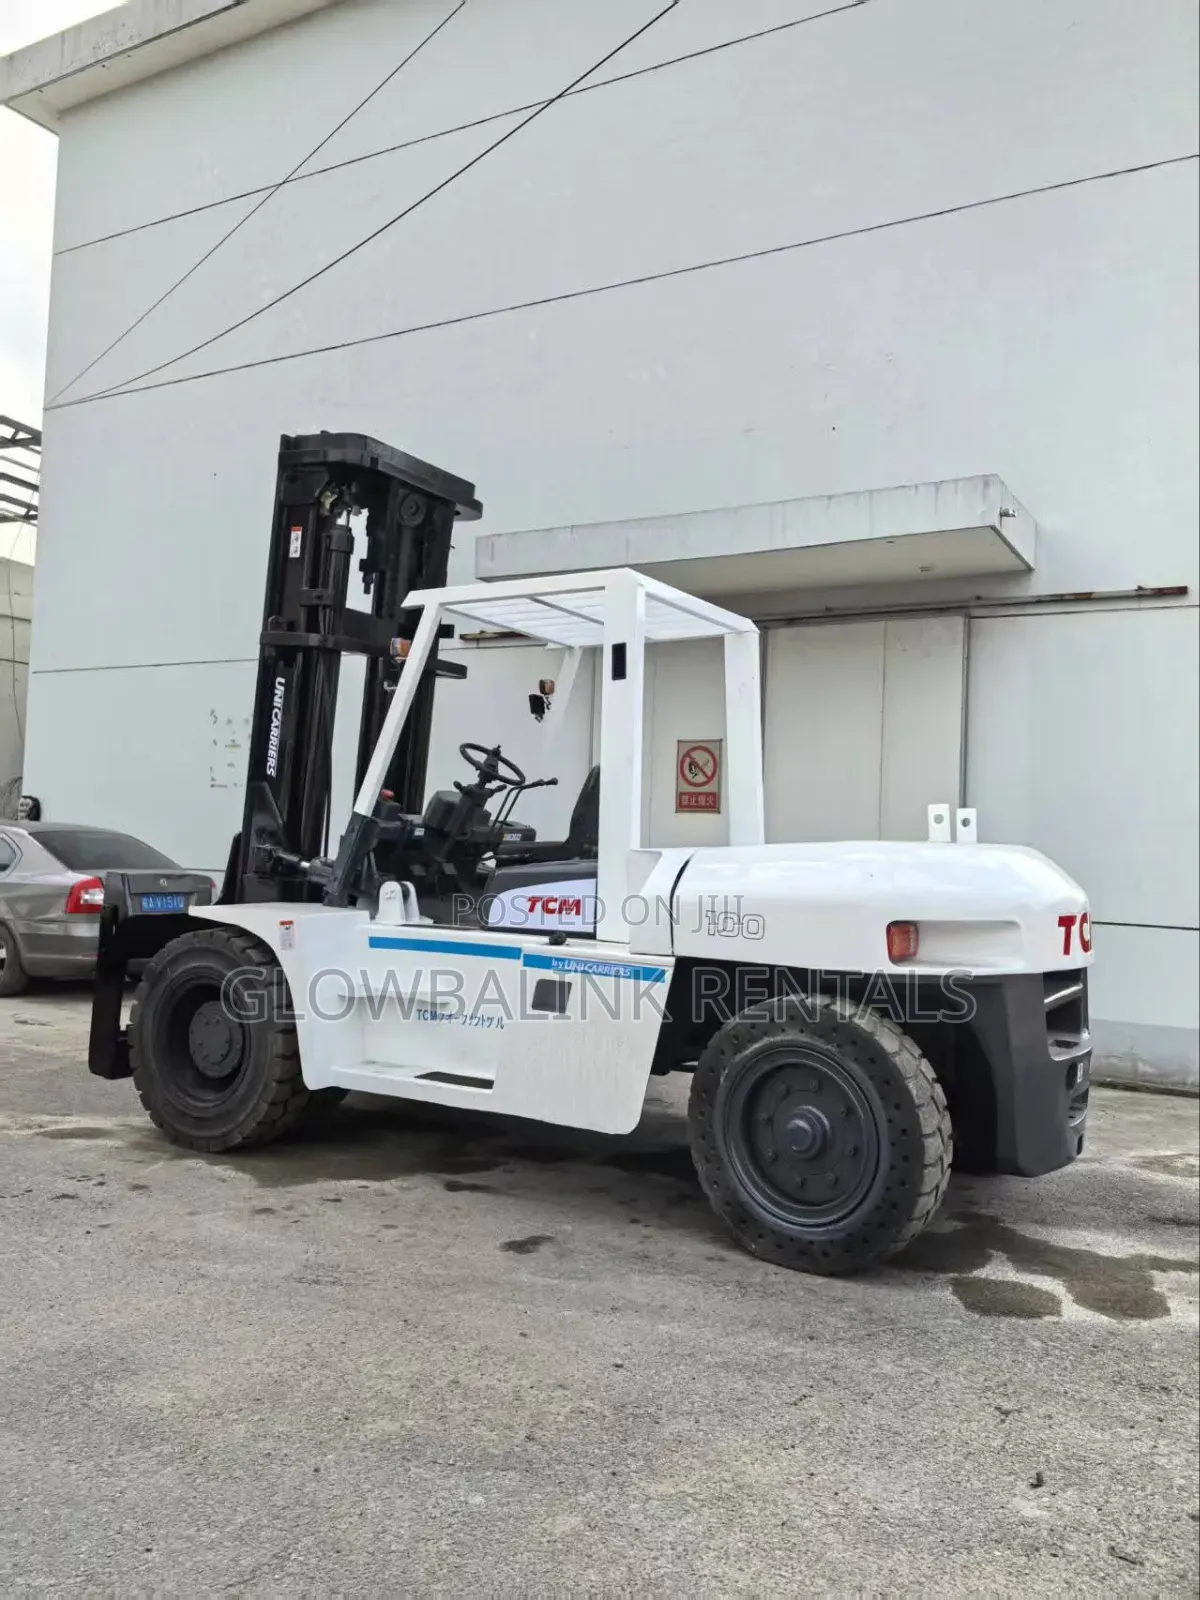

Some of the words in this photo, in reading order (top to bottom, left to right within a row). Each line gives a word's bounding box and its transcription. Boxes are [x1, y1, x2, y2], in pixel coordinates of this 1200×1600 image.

[266, 677, 286, 778] UNICARRIERS
[527, 896, 582, 916] TCM
[705, 909, 766, 941] 100
[1057, 912, 1092, 956] TC
